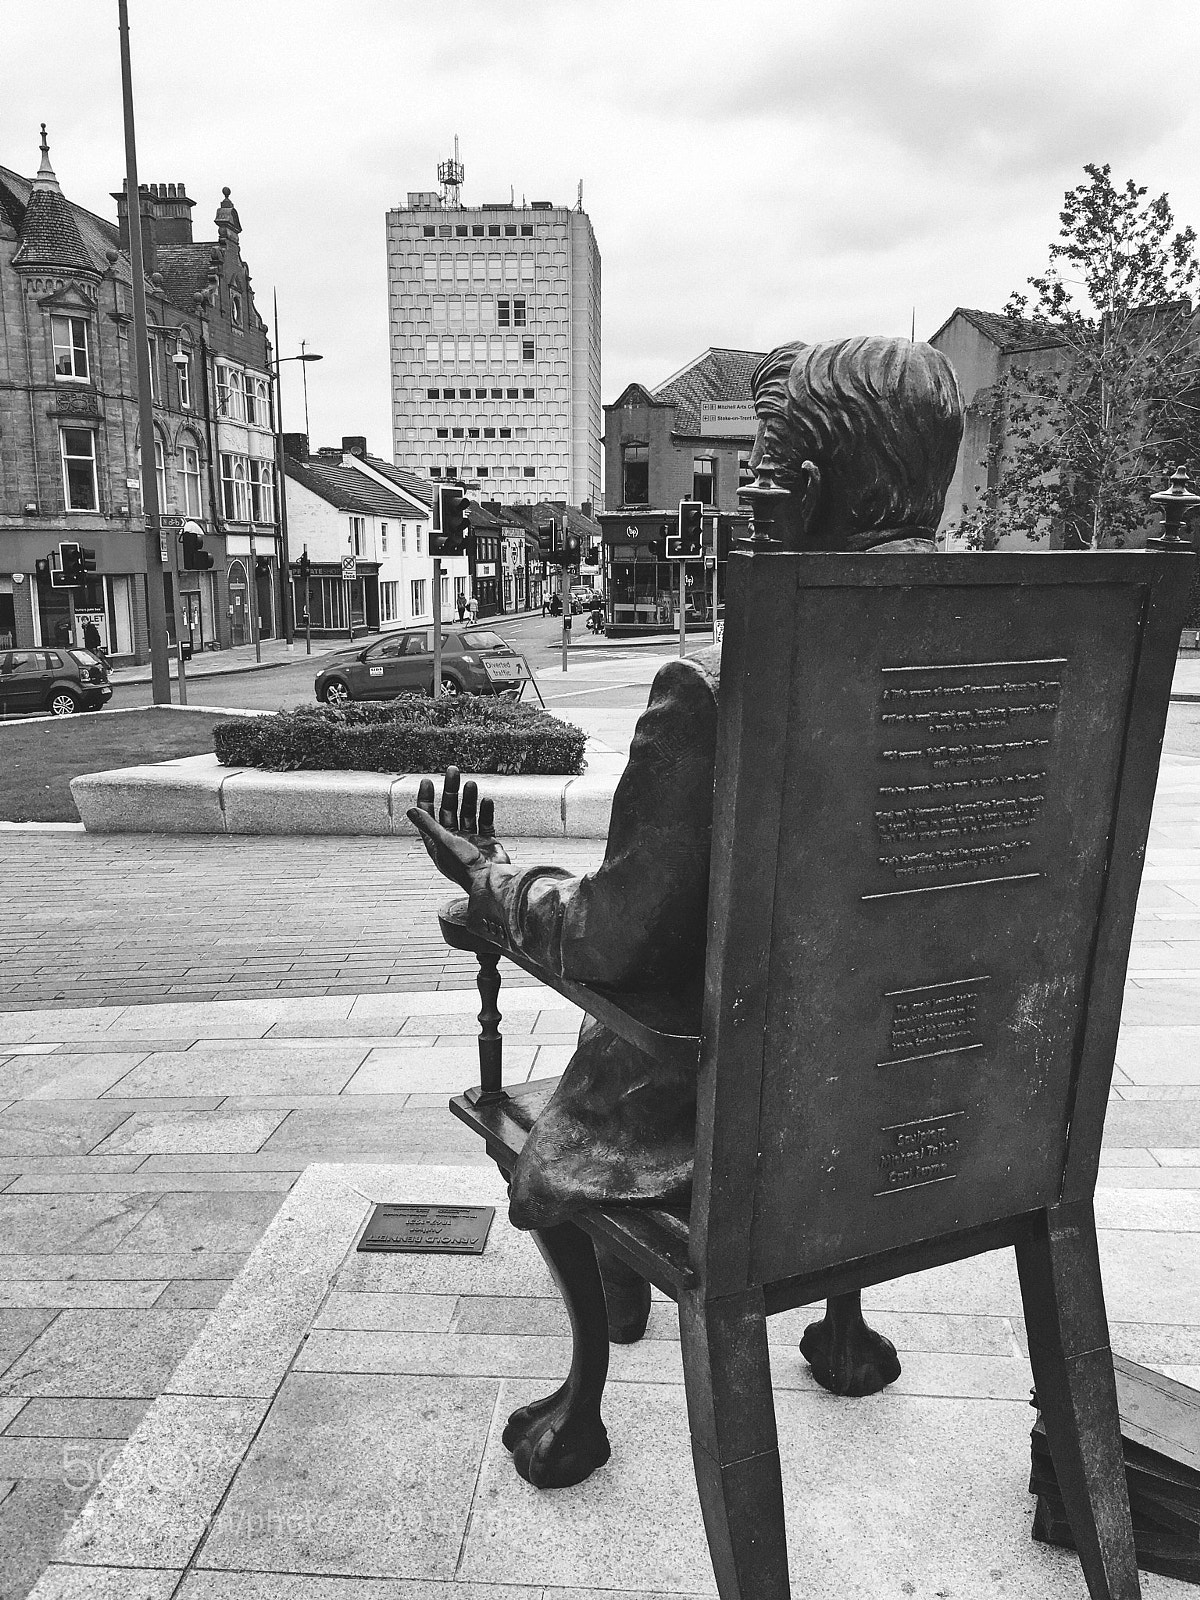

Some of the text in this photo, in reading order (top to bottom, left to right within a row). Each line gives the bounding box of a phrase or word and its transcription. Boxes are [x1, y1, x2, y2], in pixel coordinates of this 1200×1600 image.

[485, 661, 511, 669] Diverted
[493, 669, 512, 677] traffic
[425, 1236, 479, 1245] ARNOLD
